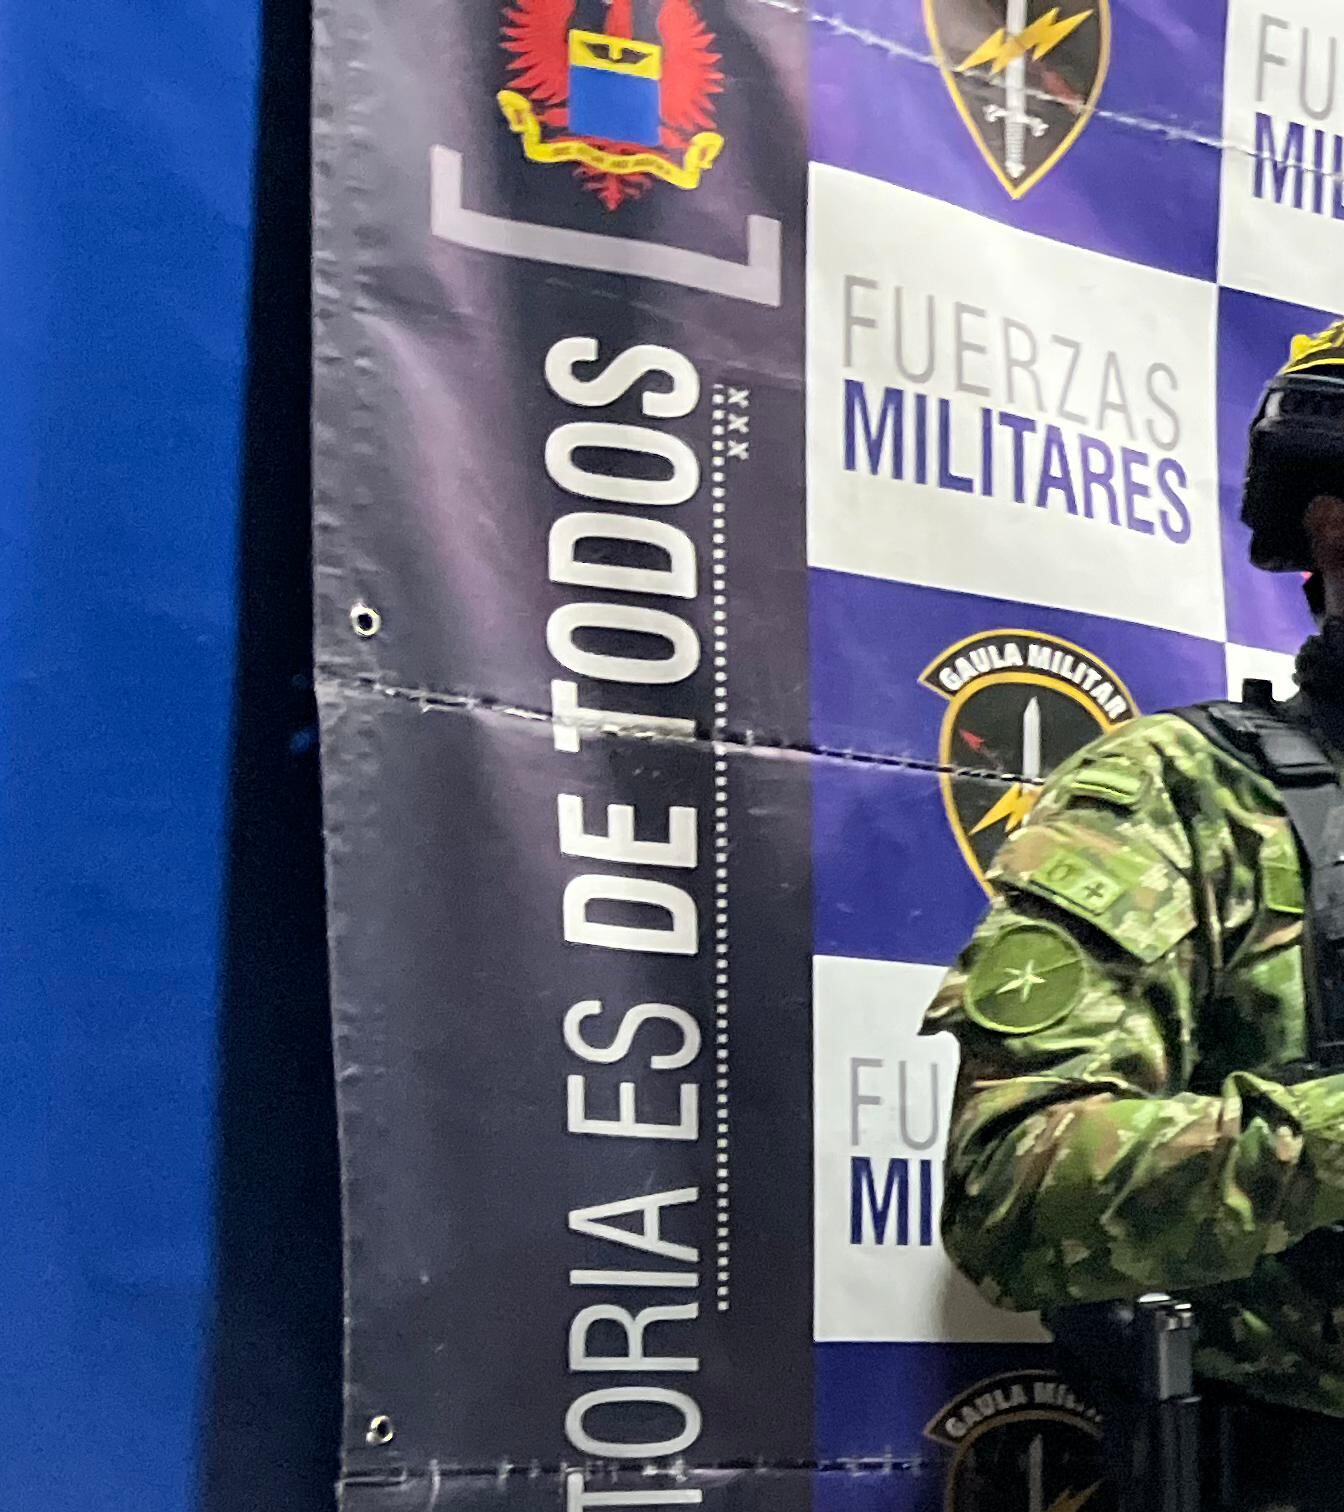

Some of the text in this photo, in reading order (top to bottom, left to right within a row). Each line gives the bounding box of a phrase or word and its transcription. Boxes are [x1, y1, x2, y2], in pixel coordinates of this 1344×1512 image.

[841, 274, 1182, 454] FUERZAS
[843, 379, 1193, 545] MILITARES
[544, 336, 702, 754] TODOS
[938, 642, 1129, 720] GAULA MILITAR
[557, 793, 700, 956] DE
[562, 999, 702, 1141] ES
